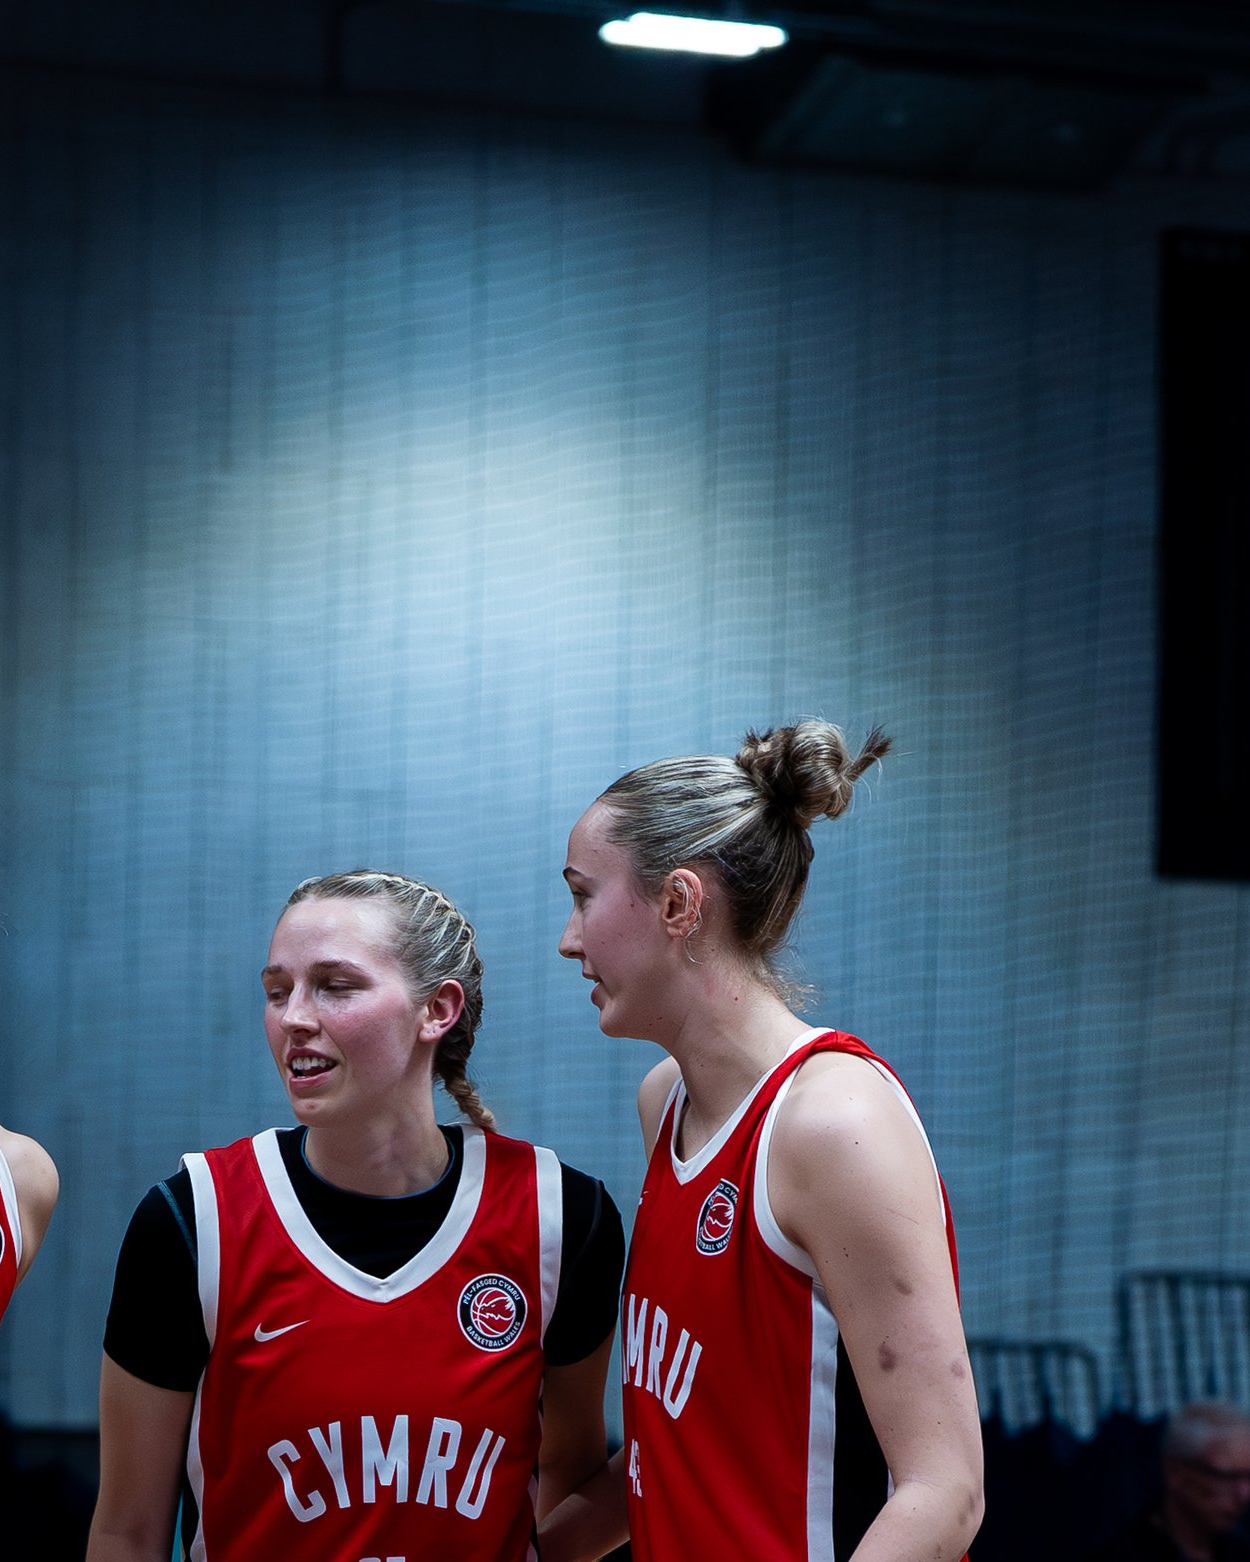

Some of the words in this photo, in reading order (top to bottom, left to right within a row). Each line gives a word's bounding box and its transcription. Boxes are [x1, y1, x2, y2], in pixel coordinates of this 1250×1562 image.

[498, 1280, 521, 1301] CYMRU
[466, 1325, 504, 1347] BASKETBALL
[504, 1321, 521, 1343] WALES
[622, 1294, 702, 1420] MRU
[267, 1414, 506, 1523] CYMRU
